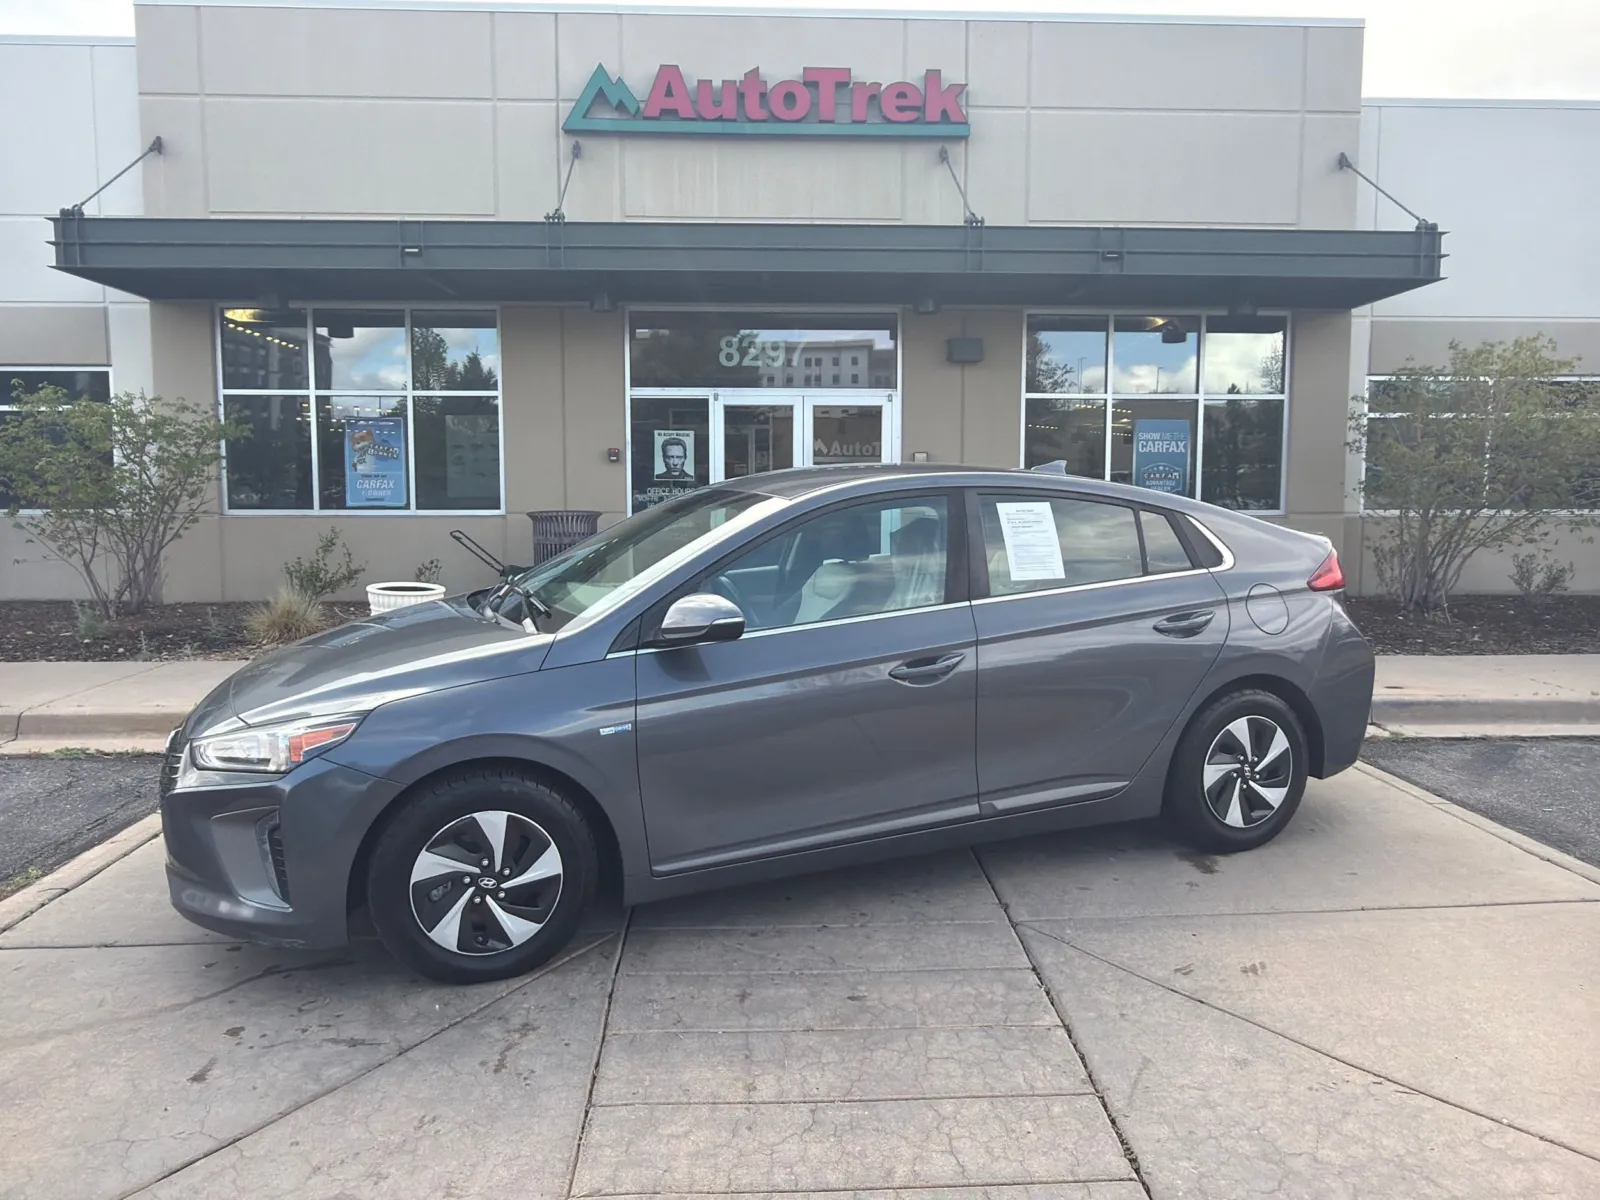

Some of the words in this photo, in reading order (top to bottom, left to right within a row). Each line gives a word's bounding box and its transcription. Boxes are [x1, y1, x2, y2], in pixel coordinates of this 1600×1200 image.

[643, 64, 968, 123] AutoTrek
[718, 335, 808, 367] 8297
[1138, 432, 1161, 440] SHOW
[1138, 440, 1186, 453] CARFAX
[356, 479, 395, 489] CARFAX
